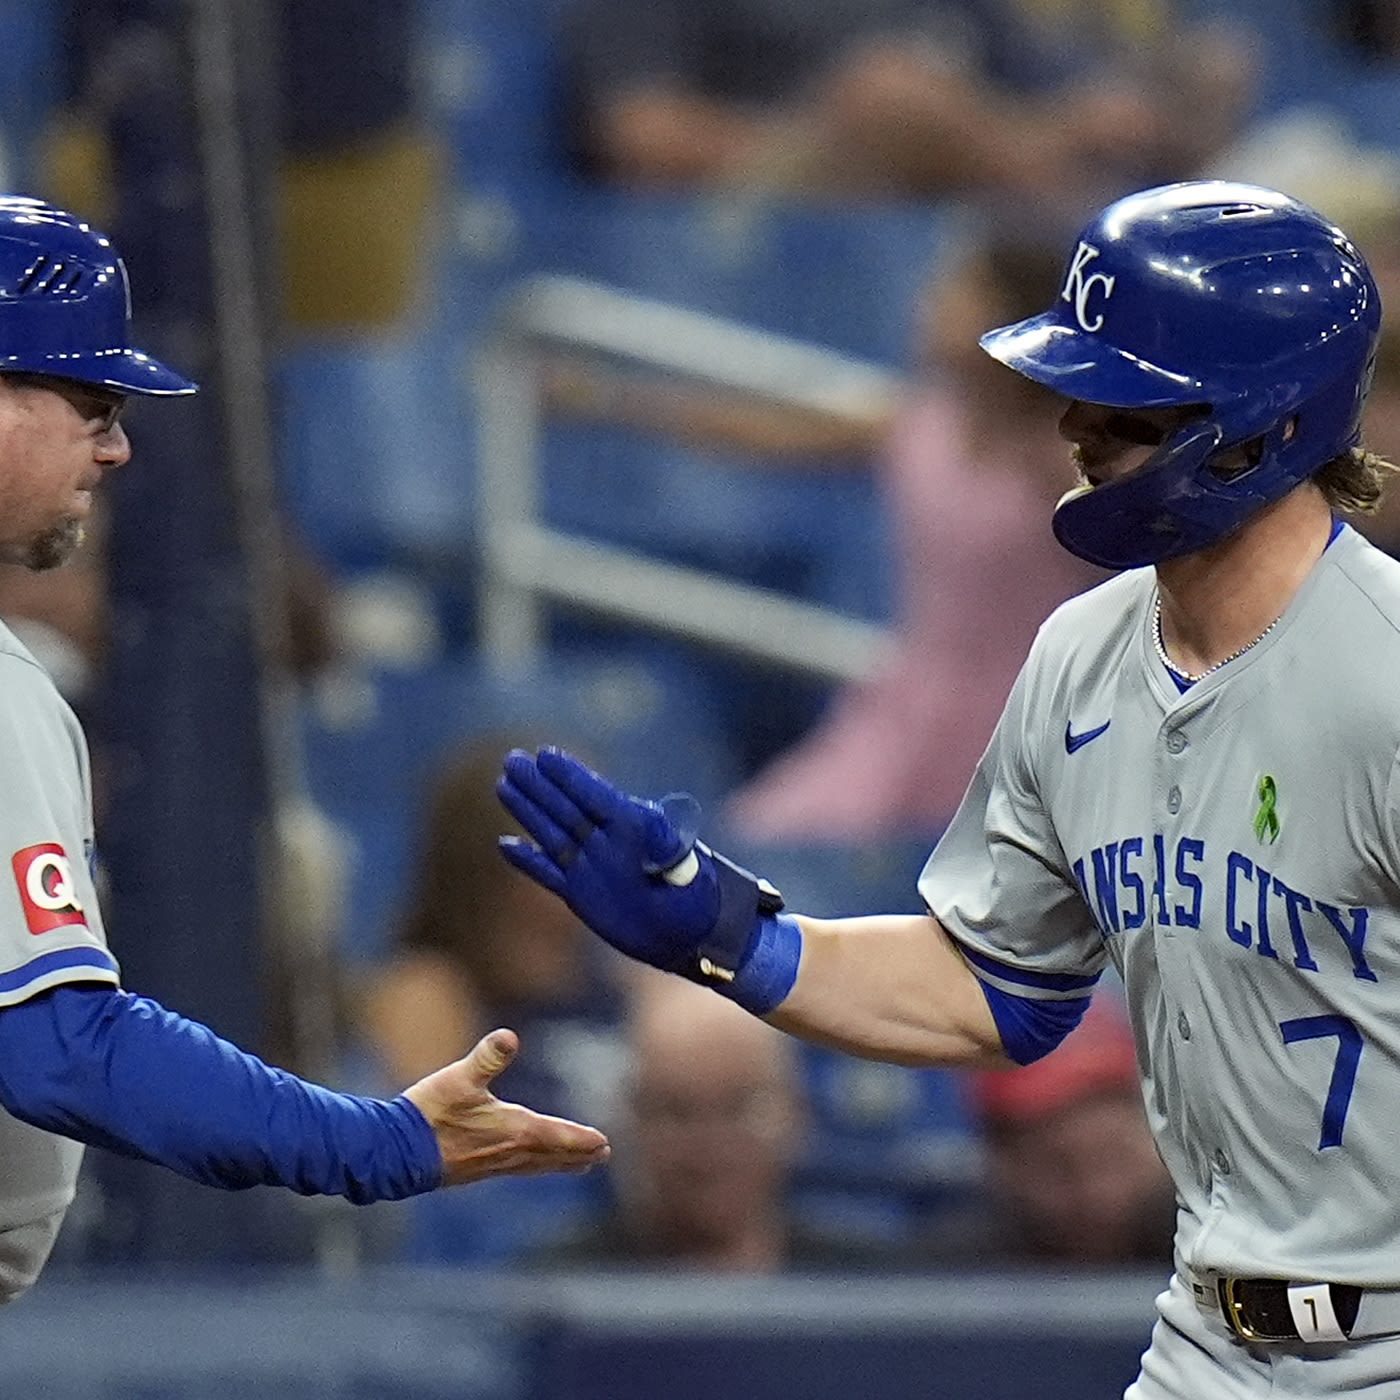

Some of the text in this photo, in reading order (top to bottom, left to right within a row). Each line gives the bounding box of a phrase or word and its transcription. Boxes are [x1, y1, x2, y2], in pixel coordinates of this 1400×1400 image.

[1061, 241, 1116, 333] KC
[25, 852, 85, 911] Q
[1225, 850, 1379, 983] CITY
[1279, 1014, 1364, 1151] 7
